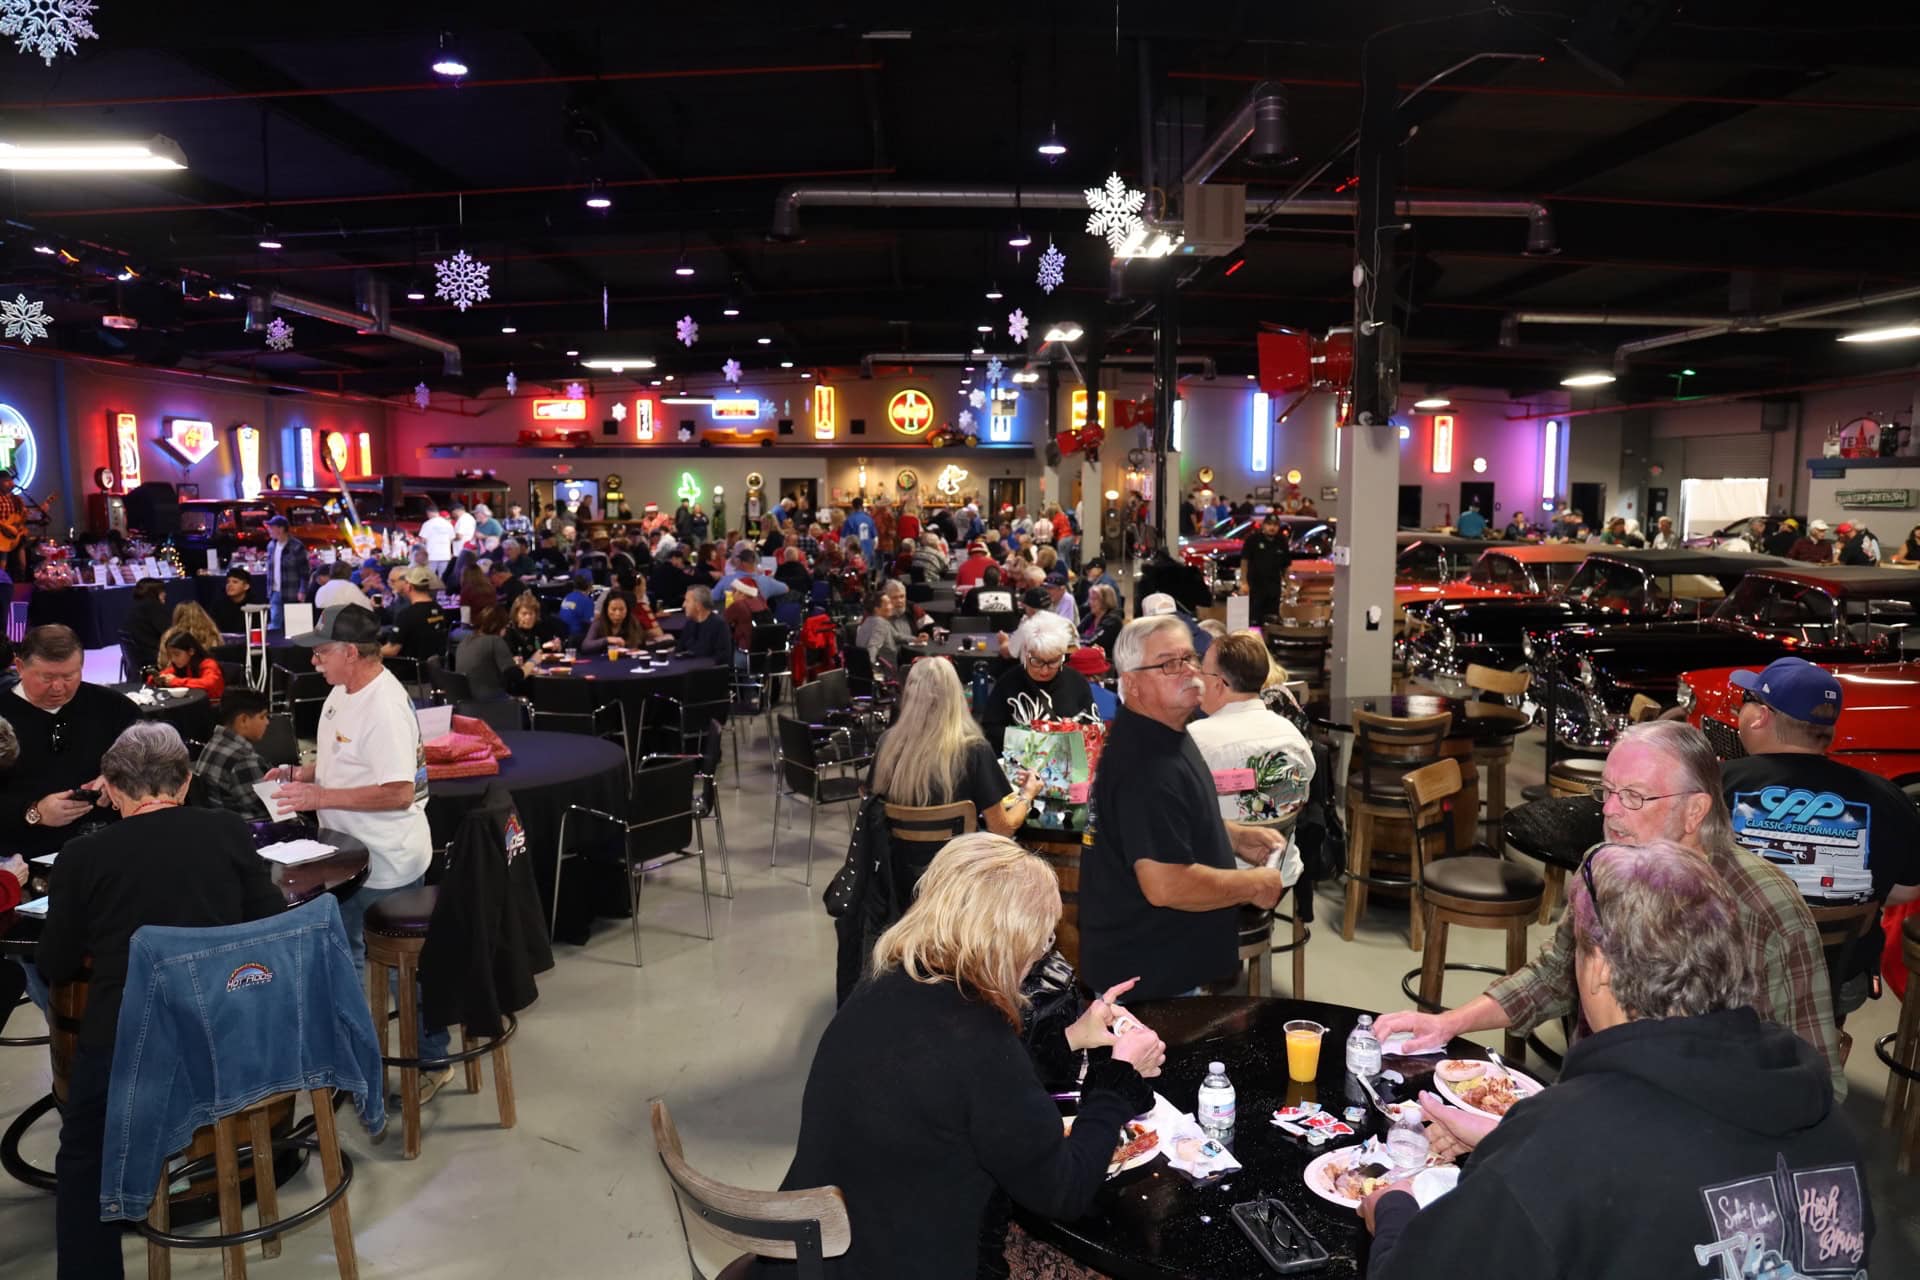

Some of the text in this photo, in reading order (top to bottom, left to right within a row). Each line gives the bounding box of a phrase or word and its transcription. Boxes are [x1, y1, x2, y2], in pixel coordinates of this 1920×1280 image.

[1760, 786, 1845, 823] CPP
[1745, 818, 1858, 838] CLASSIC PERFORMANCE
[226, 977, 244, 990] HOT
[246, 972, 273, 985] RODS
[1799, 1185, 1840, 1232] High
